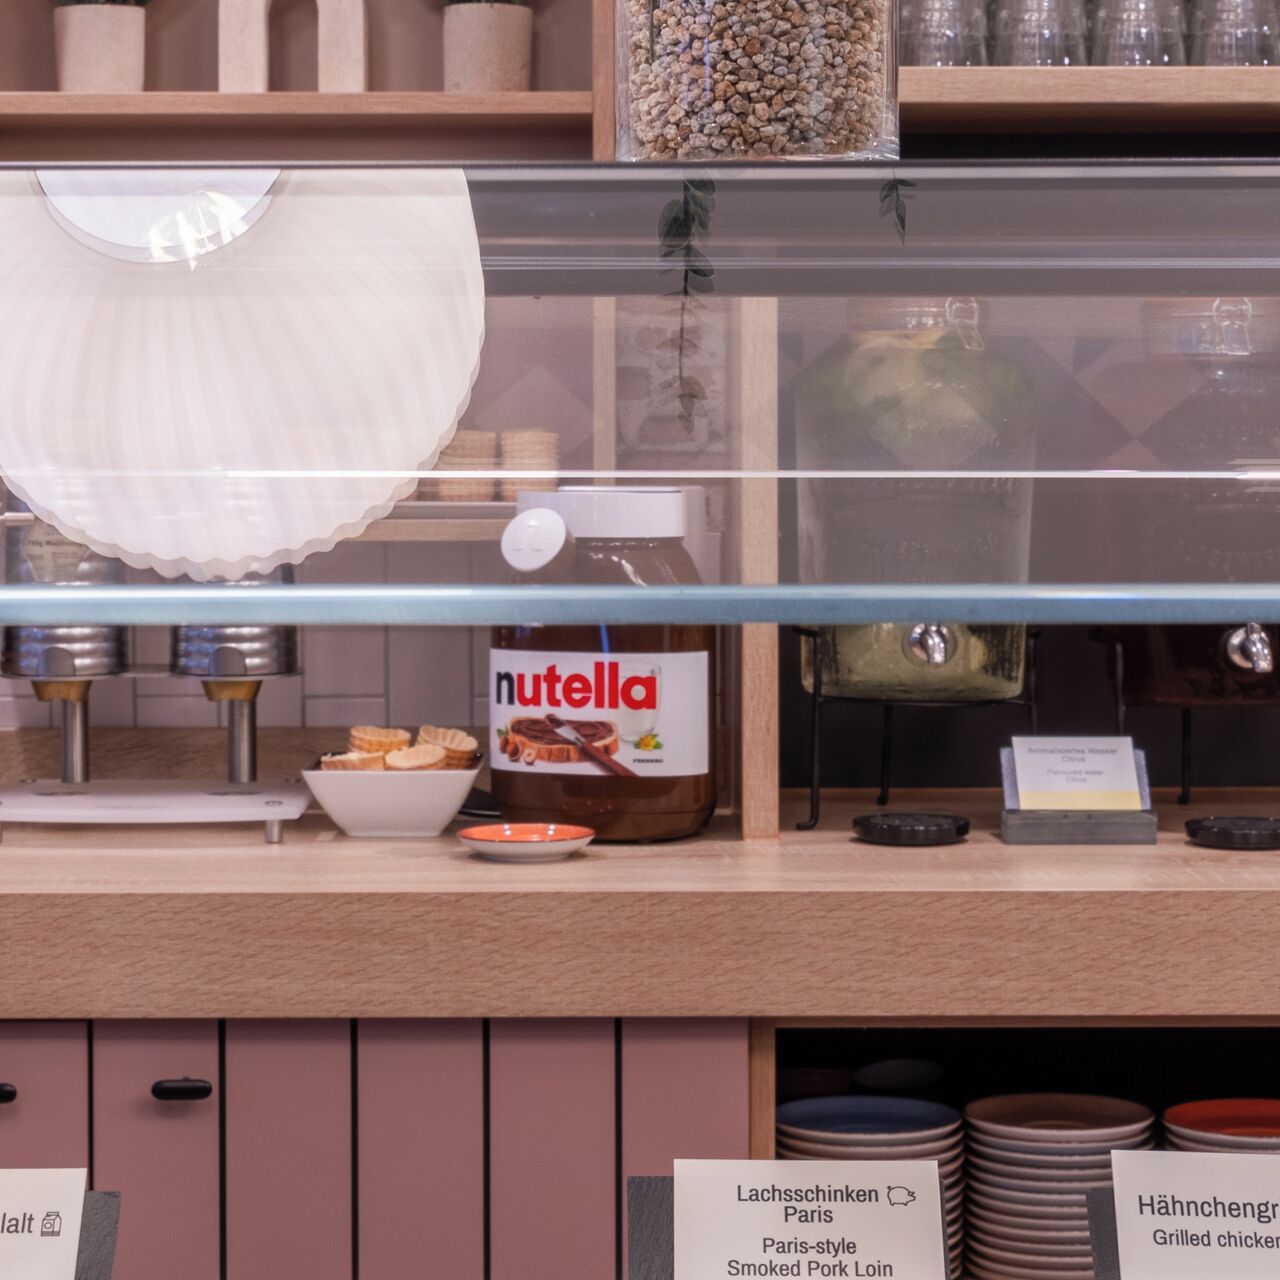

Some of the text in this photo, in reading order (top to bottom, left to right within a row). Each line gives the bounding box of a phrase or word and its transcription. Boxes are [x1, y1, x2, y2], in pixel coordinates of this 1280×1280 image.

[496, 662, 656, 710] nutella
[738, 1184, 878, 1202] Lachsschinken
[785, 1205, 833, 1223] Paris
[763, 1237, 856, 1255] Paris-style
[1153, 1229, 1211, 1246] Grilled
[728, 1260, 893, 1277] Smoked Pork Loin
